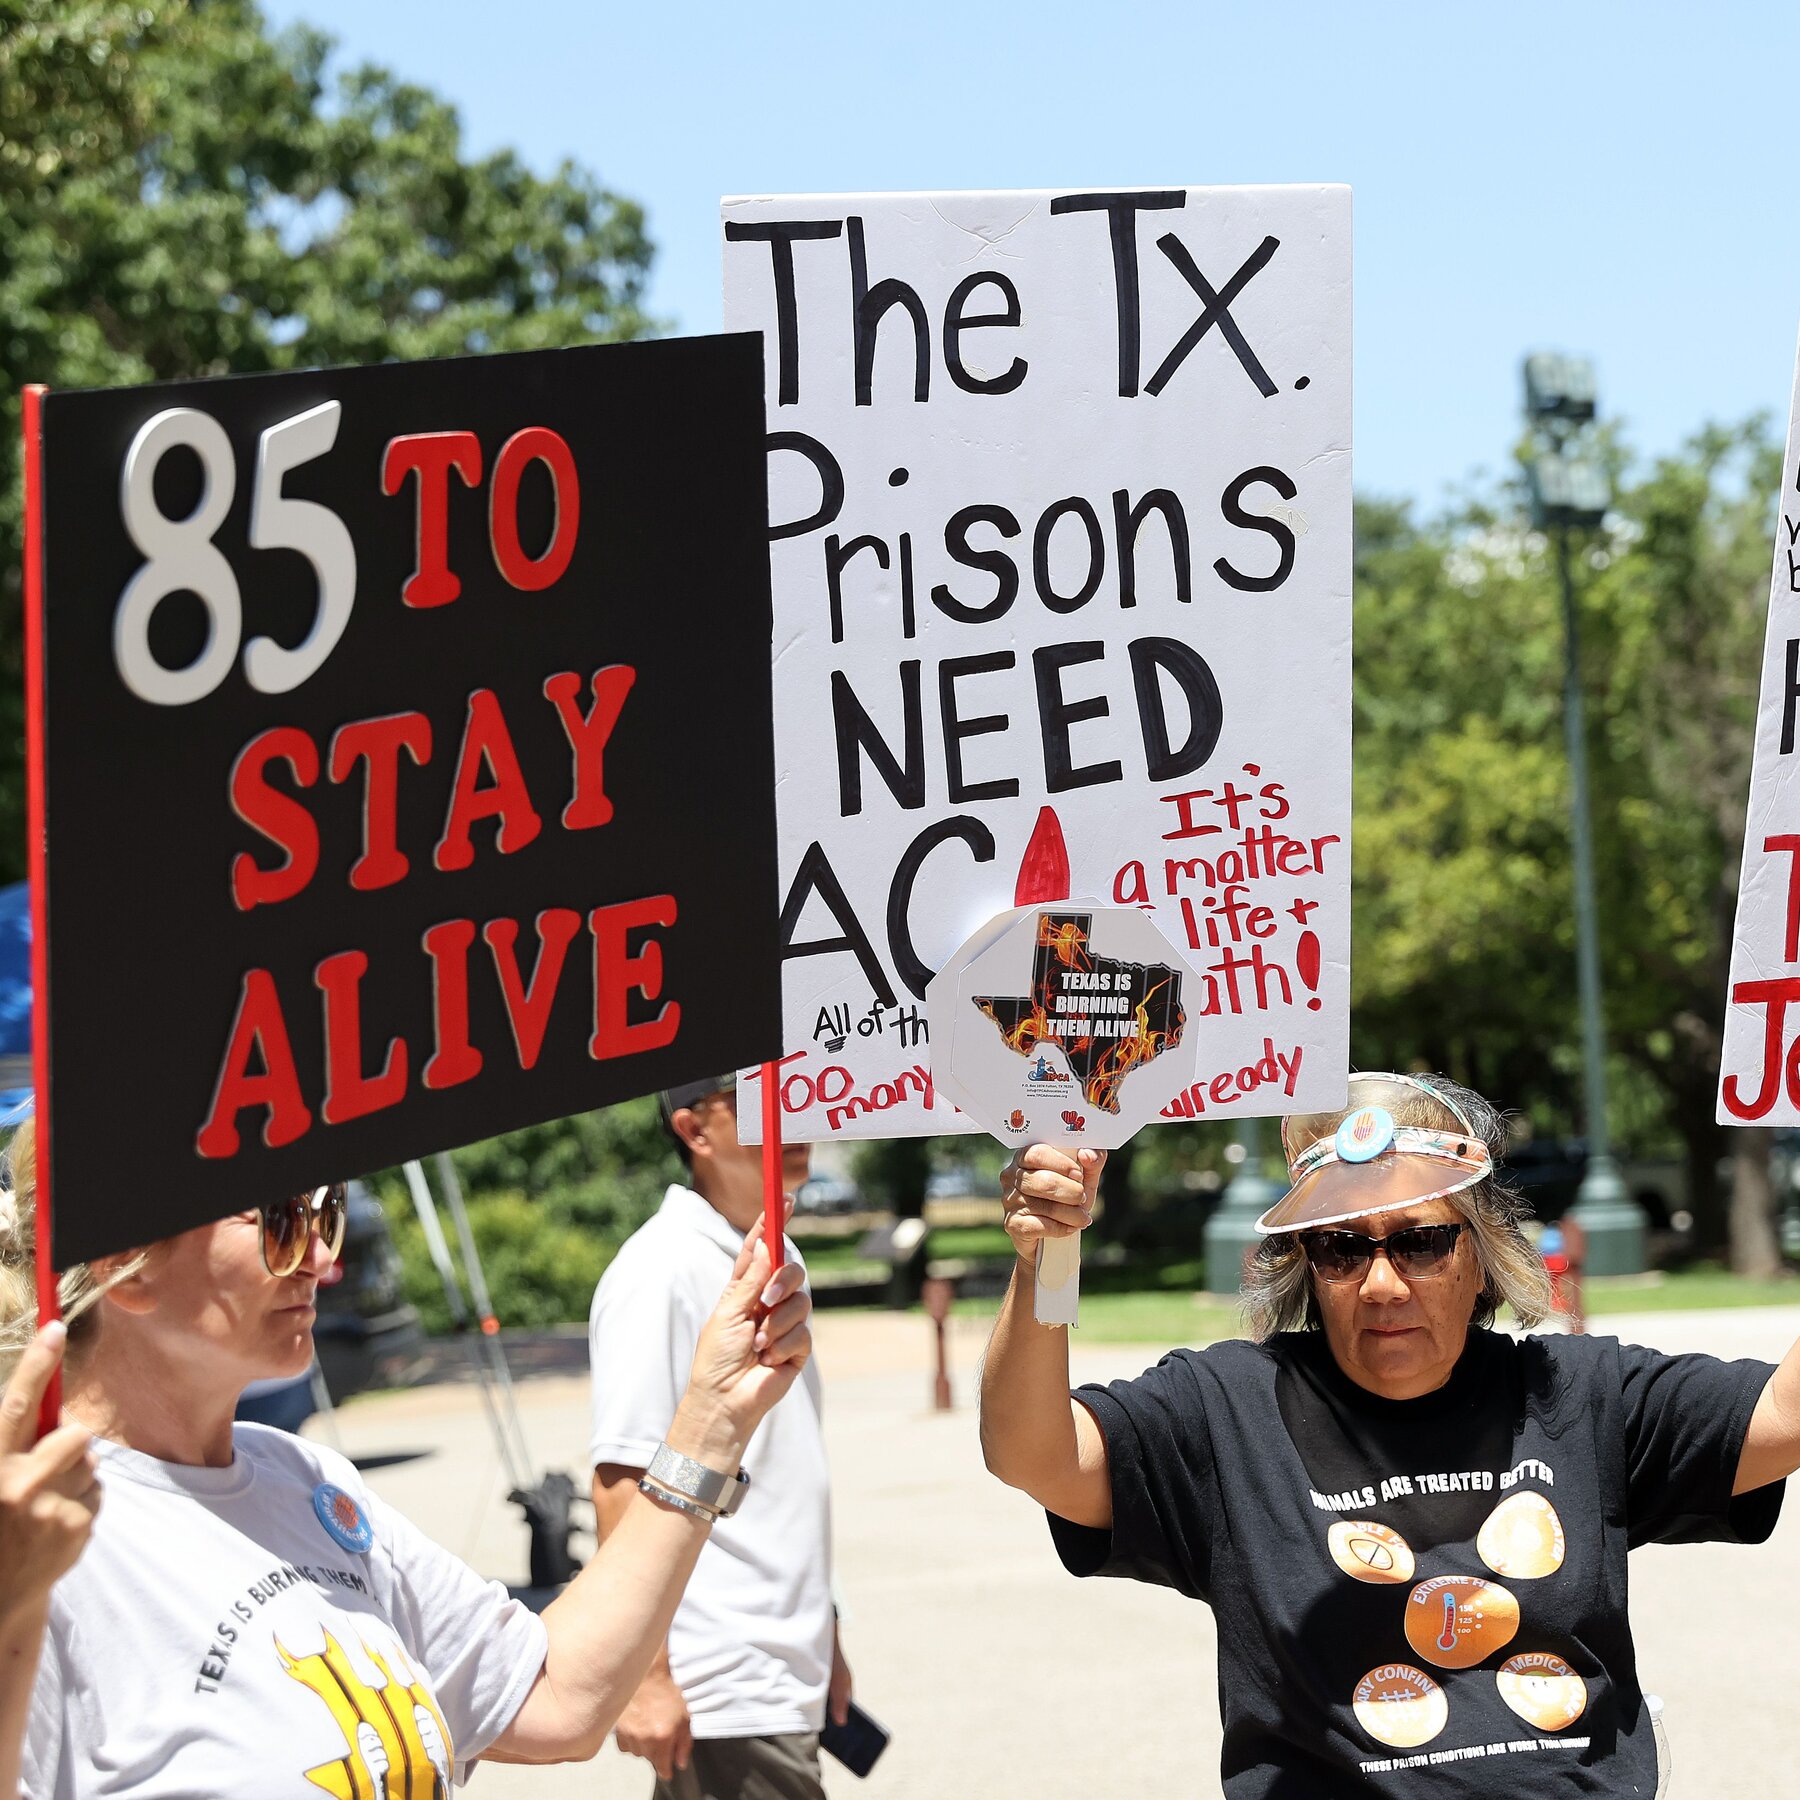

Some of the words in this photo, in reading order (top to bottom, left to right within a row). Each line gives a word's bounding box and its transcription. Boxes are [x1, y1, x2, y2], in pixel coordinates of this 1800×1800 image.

[725, 216, 1029, 407] The
[113, 399, 357, 707] 85
[380, 425, 581, 609] TO
[832, 636, 1224, 818] NEED
[229, 664, 637, 911] STAY
[1159, 763, 1290, 840] It's
[1112, 859, 1149, 904] a
[1164, 824, 1341, 896] matter
[1180, 885, 1278, 950] life
[1055, 996, 1129, 1015] BURNING
[1061, 972, 1111, 991] TEXAS
[1114, 973, 1132, 992] IS
[196, 894, 682, 1159] ALIVE
[812, 1002, 851, 1042] All
[856, 998, 884, 1037] of
[1046, 1018, 1091, 1038] THEM
[1093, 1020, 1140, 1038] ALIVE
[826, 1064, 936, 1131] many
[1380, 1476, 1414, 1502] ARE
[1415, 1471, 1494, 1494] TREATED
[1412, 1576, 1469, 1605] EXTREME
[194, 1621, 239, 1694] TEXAS
[230, 1600, 253, 1624] IS
[317, 1566, 368, 1595] THEM
[1392, 1754, 1429, 1770] PRISON
[1429, 1745, 1486, 1764] CONDITIONS
[1486, 1742, 1507, 1756] ARE
